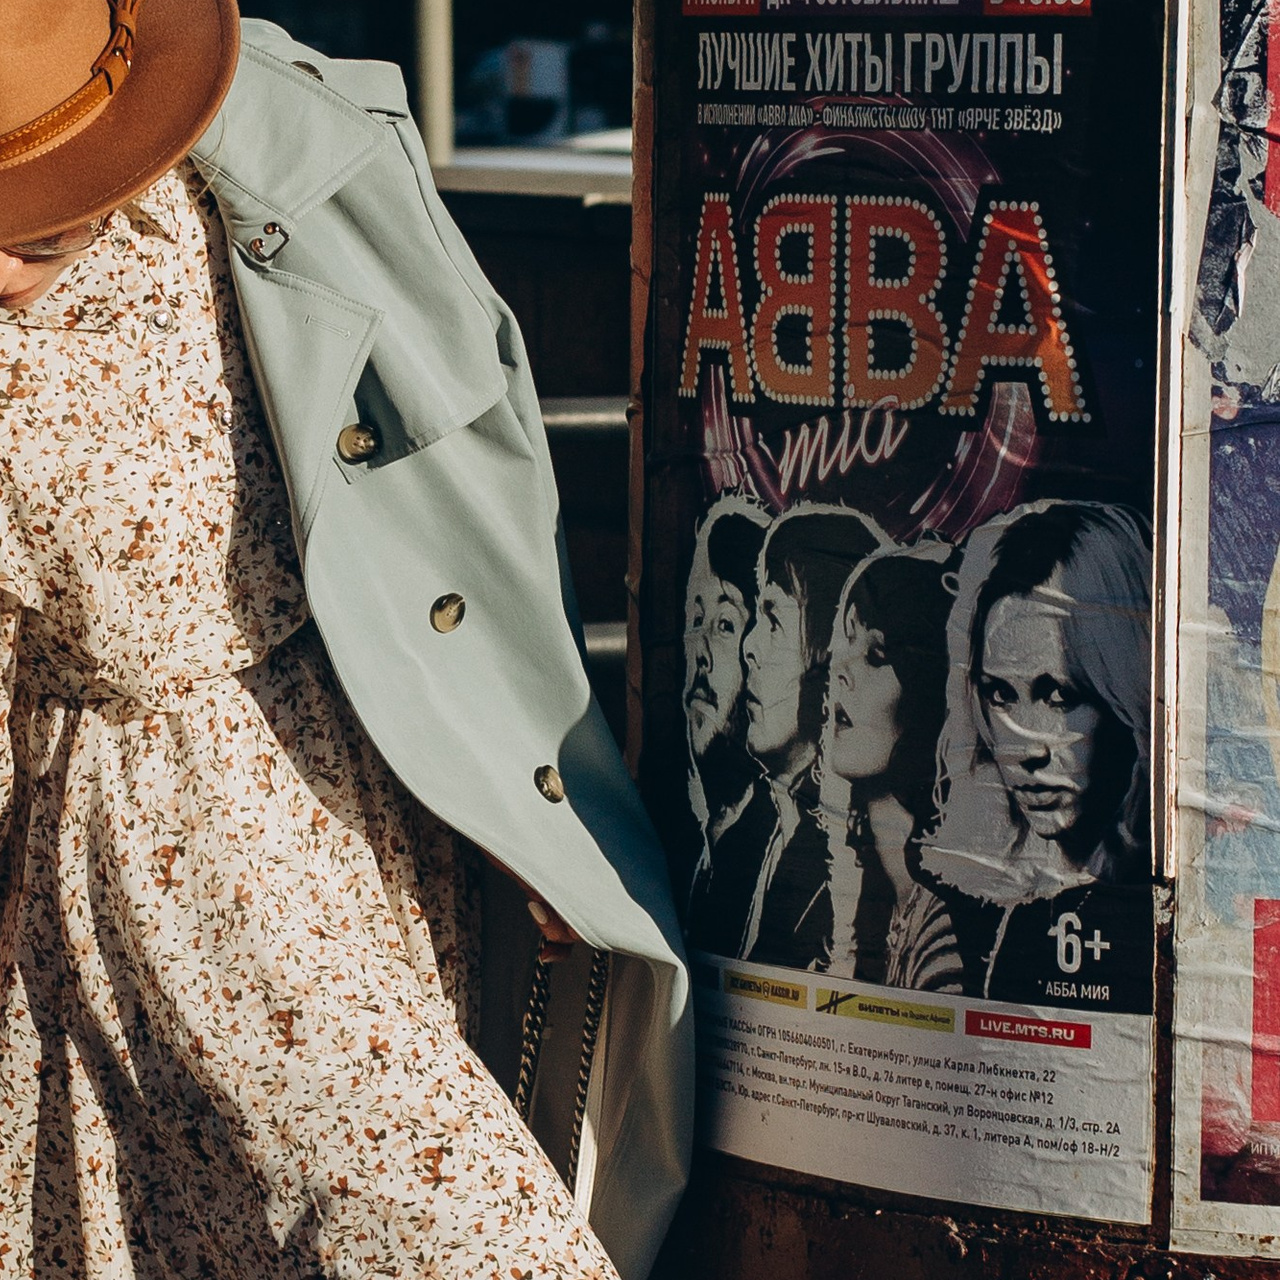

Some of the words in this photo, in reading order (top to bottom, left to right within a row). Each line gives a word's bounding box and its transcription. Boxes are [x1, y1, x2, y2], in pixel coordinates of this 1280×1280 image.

[697, 32, 797, 92] ЛУЧШИЕ
[804, 32, 893, 94] ХИТЫ
[903, 32, 1063, 96] ГРУППЫ
[703, 103, 756, 126] ИСПОЛНЕНИИ
[822, 105, 898, 129] ФИНАЛИСТЫ
[898, 106, 926, 129] ШОУ
[930, 107, 955, 130] ТНТ
[958, 107, 1000, 130] «ЯРЧЕ
[1003, 105, 1063, 134] ЗВЁЗД»
[678, 191, 1091, 424] ABBA
[765, 395, 909, 496] mia
[1056, 911, 1111, 974] 6+
[858, 1002, 900, 1017] БИЛЕТЫ
[1045, 980, 1078, 999] АББА
[1080, 983, 1110, 1001] МИЯ
[757, 1024, 777, 1040] ОГРН
[840, 1043, 846, 1053] г.
[848, 1042, 910, 1065] Екатеринбург,
[912, 1054, 941, 1068] улица
[944, 1057, 975, 1074] Карла
[978, 1061, 1040, 1082] Либкнехта,
[1042, 1069, 1056, 1083] 22
[979, 1018, 1076, 1041] LIVE.MTS.RU
[751, 1066, 778, 1084] Москва,
[809, 1078, 874, 1101] Муниципальный
[875, 1090, 901, 1109] Округ
[901, 1094, 951, 1115] Таганский,
[952, 1105, 964, 1117] ул
[966, 1104, 1043, 1129] Воронцовская,
[1045, 1117, 1056, 1130] д.
[1059, 1116, 1079, 1132] 1/3,
[1081, 1121, 1103, 1135] стр.
[1106, 1121, 1121, 1135] 2А
[757, 1046, 818, 1070] Санкт-Петербург,
[833, 1061, 851, 1076] 15-я
[873, 1071, 882, 1083] д.
[884, 1070, 894, 1083] 76
[895, 1074, 922, 1090] литер
[935, 1080, 971, 1095] помещ.
[974, 1083, 997, 1098] 27-н
[1000, 1087, 1027, 1103] офис
[1029, 1090, 1054, 1105] №12
[751, 1090, 771, 1103] адрес
[866, 1111, 931, 1134] Шуваловский,
[932, 1124, 942, 1136] д.
[944, 1123, 959, 1139] 37,
[973, 1127, 981, 1142] 1,
[984, 1131, 1020, 1147] литера
[1023, 1134, 1034, 1148] А,
[1037, 1137, 1078, 1155] пом/оф
